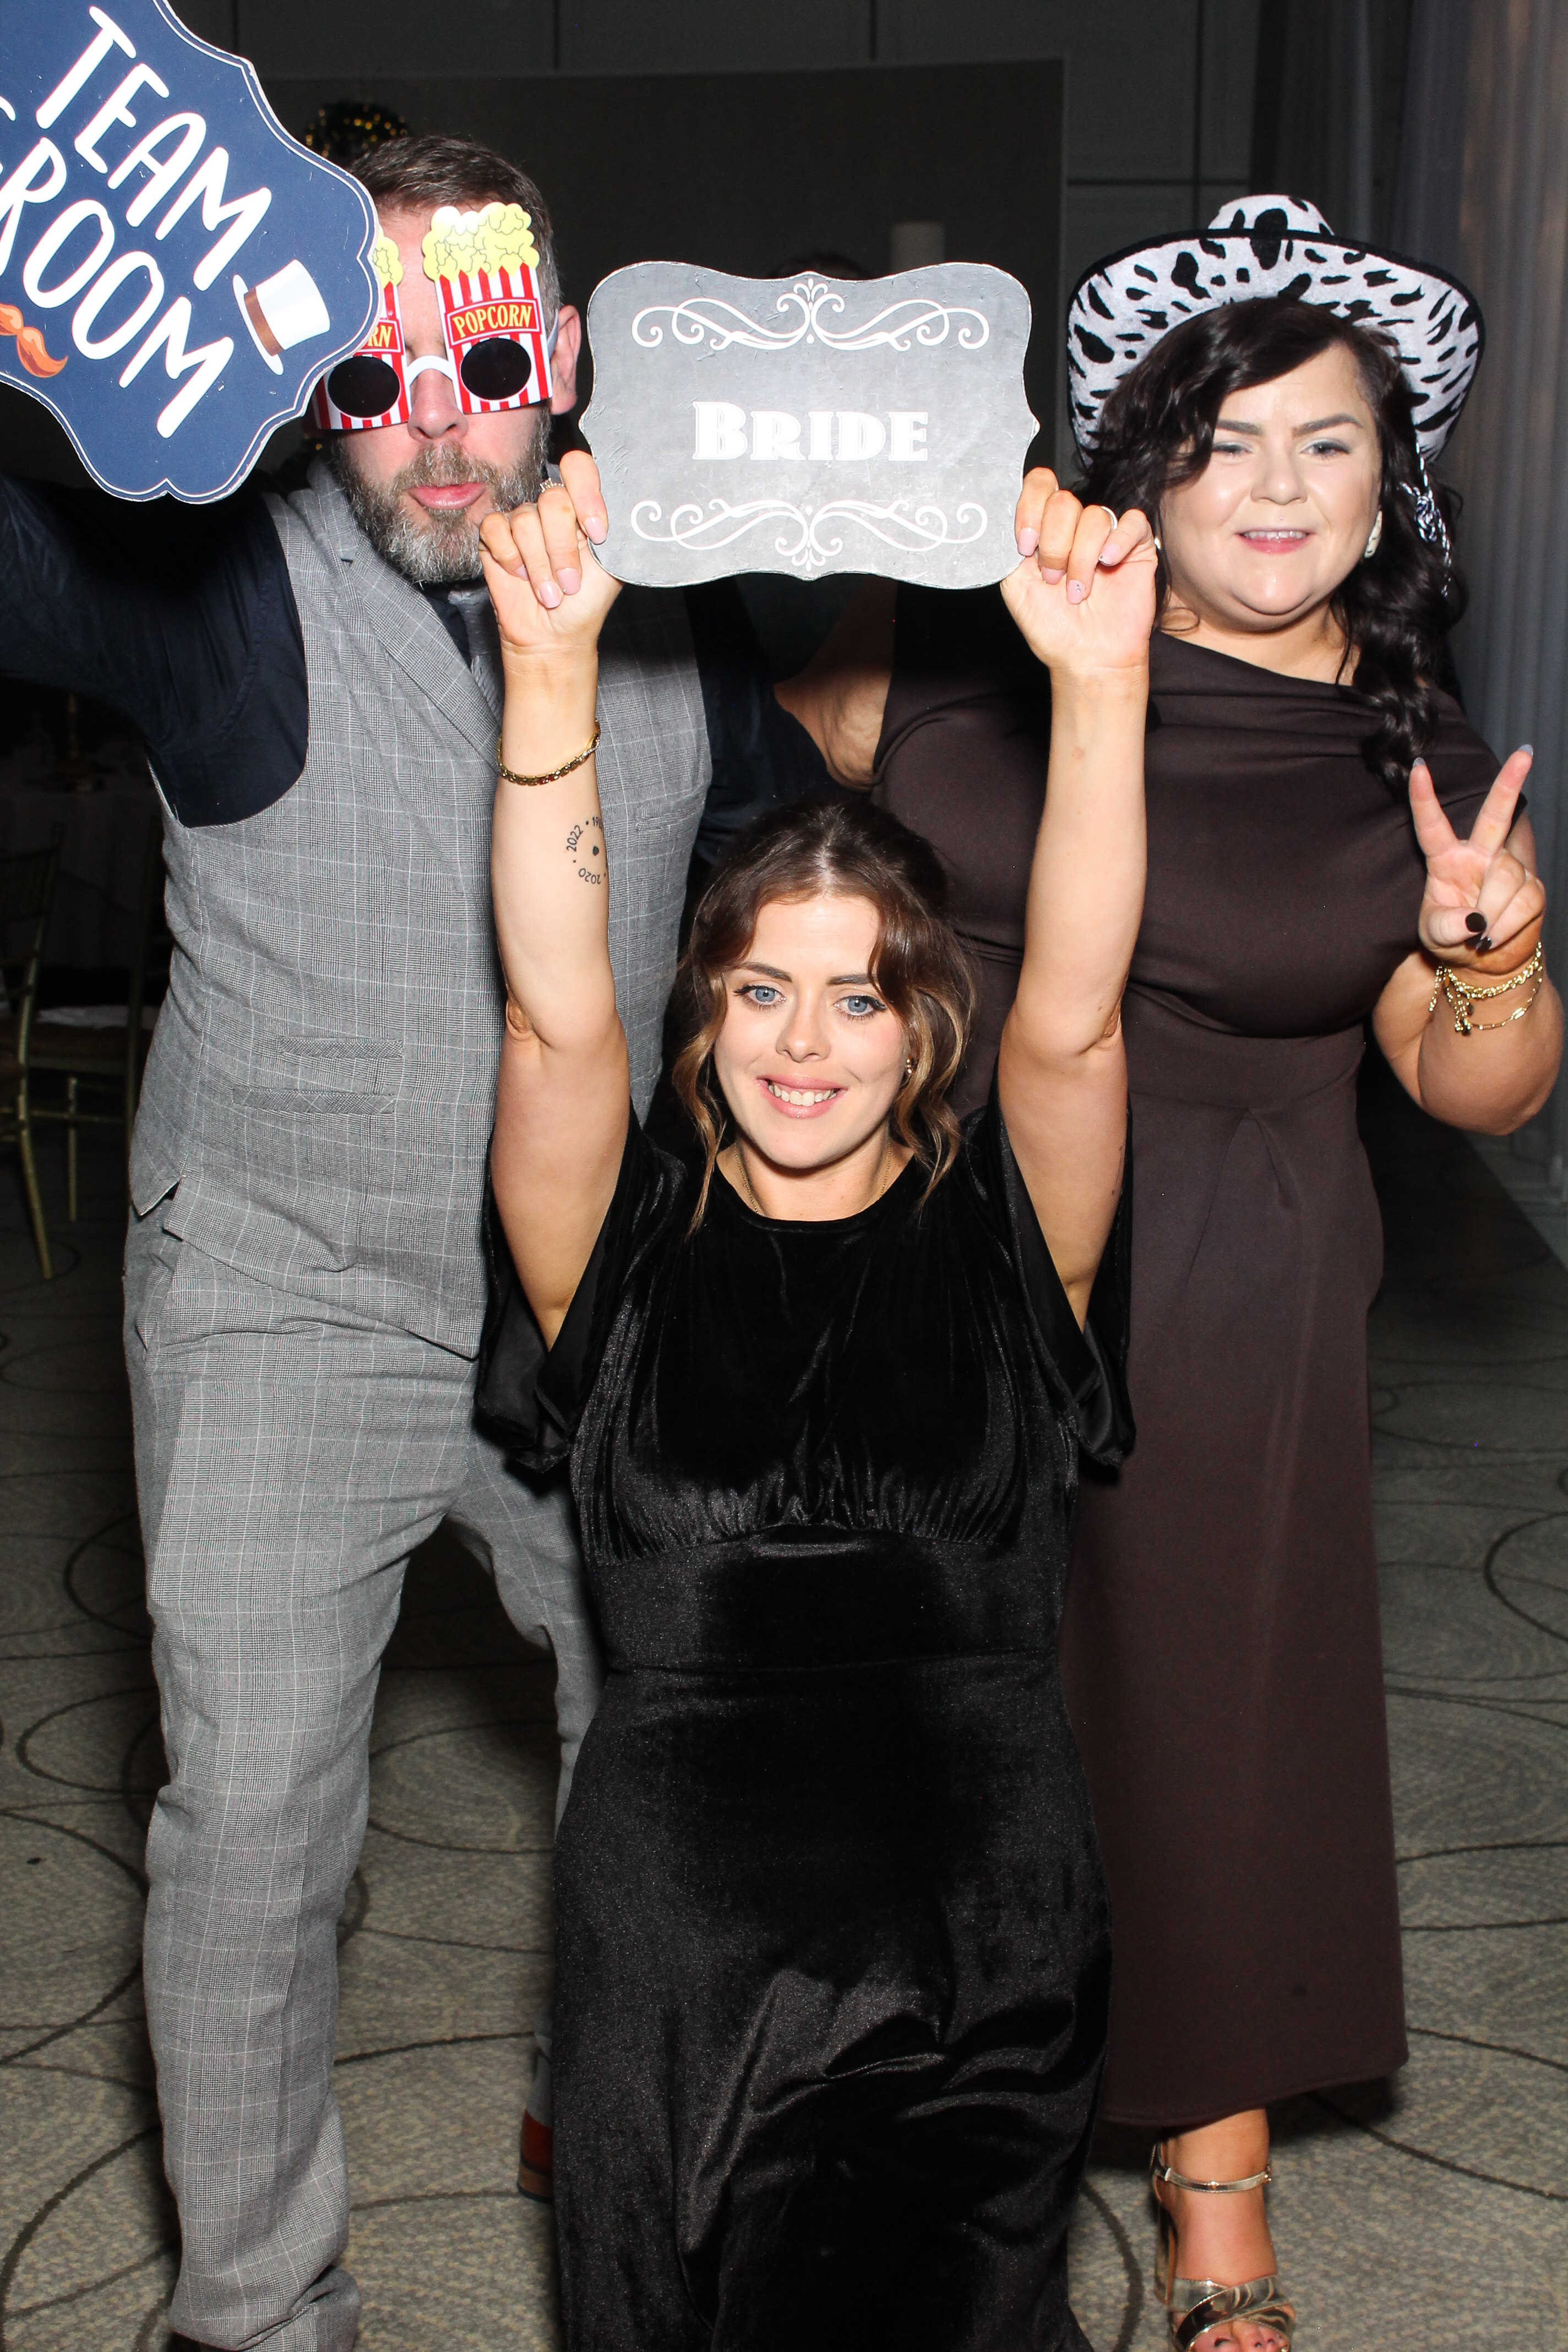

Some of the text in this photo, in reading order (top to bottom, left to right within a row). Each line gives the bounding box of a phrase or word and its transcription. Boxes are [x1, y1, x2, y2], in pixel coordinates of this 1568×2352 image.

[36, 6, 271, 291] TEAM
[0, 96, 234, 438] ROOM
[453, 304, 532, 338] POPCORN
[692, 401, 928, 461] BRIDE
[566, 825, 584, 852] 2022
[579, 868, 601, 884] 2020
